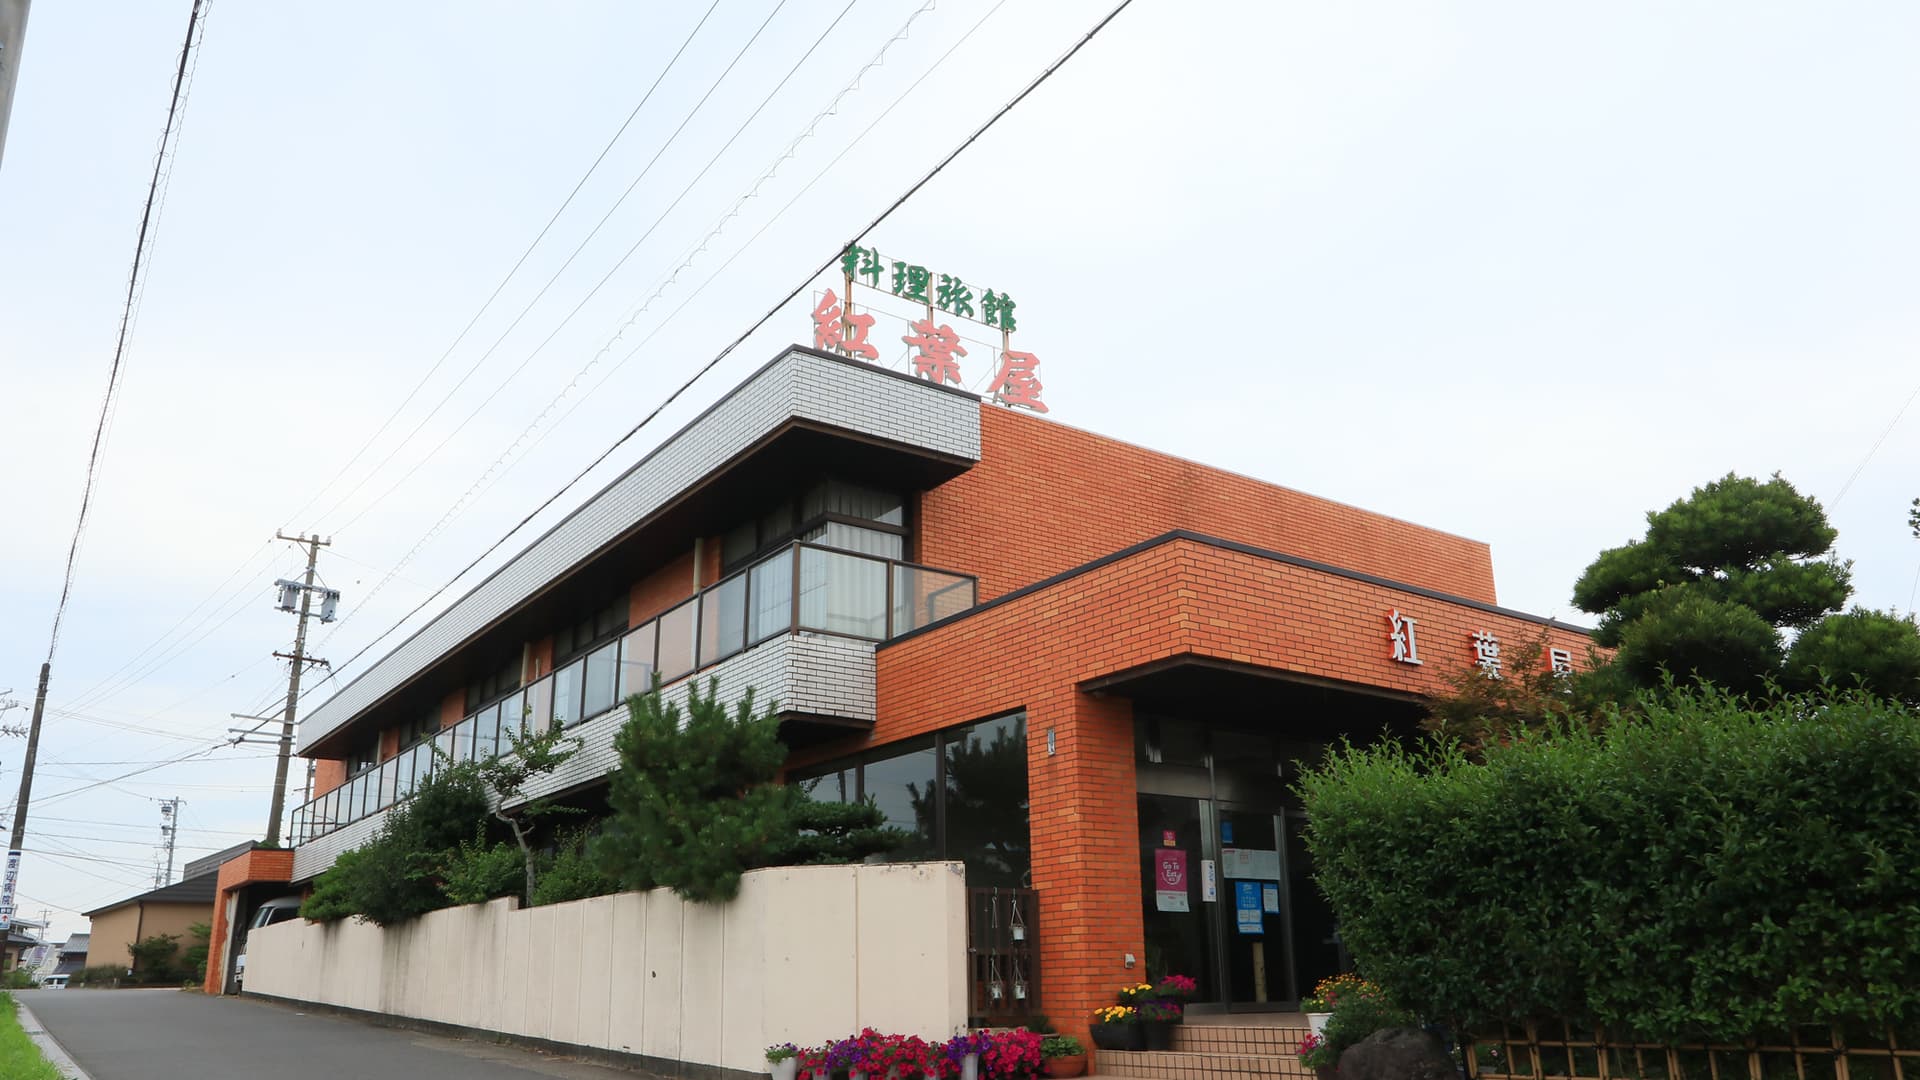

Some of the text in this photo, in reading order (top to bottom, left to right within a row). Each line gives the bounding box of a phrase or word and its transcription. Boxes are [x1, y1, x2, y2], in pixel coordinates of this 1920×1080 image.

[841, 243, 1016, 333] 料理旅館
[811, 288, 1049, 413] 紅葉屋
[1162, 861, 1180, 870] Go To
[1166, 869, 1177, 878] Eat
